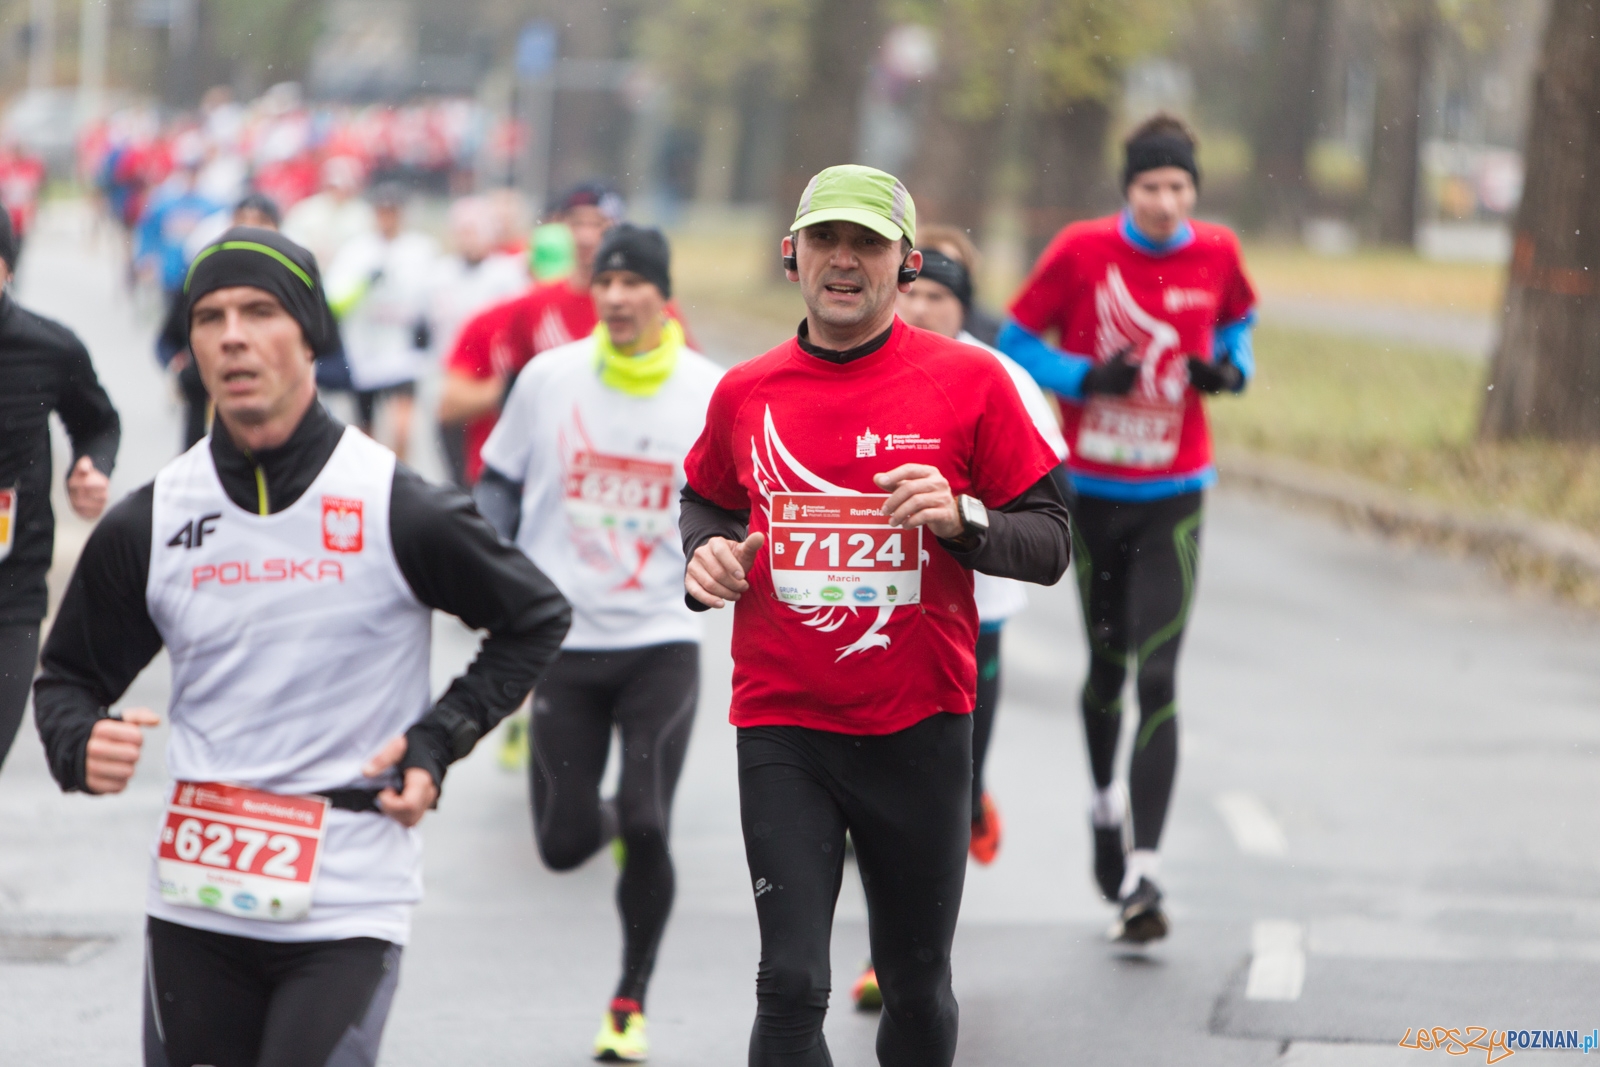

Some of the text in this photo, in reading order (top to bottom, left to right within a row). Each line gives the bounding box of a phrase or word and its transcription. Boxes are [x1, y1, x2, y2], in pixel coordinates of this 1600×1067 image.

[581, 474, 660, 507] 6201
[167, 512, 222, 549] 4F
[774, 532, 905, 567] B 7124
[192, 558, 344, 590] POLSKA
[827, 574, 861, 582] Marcin
[174, 818, 301, 880] 6272
